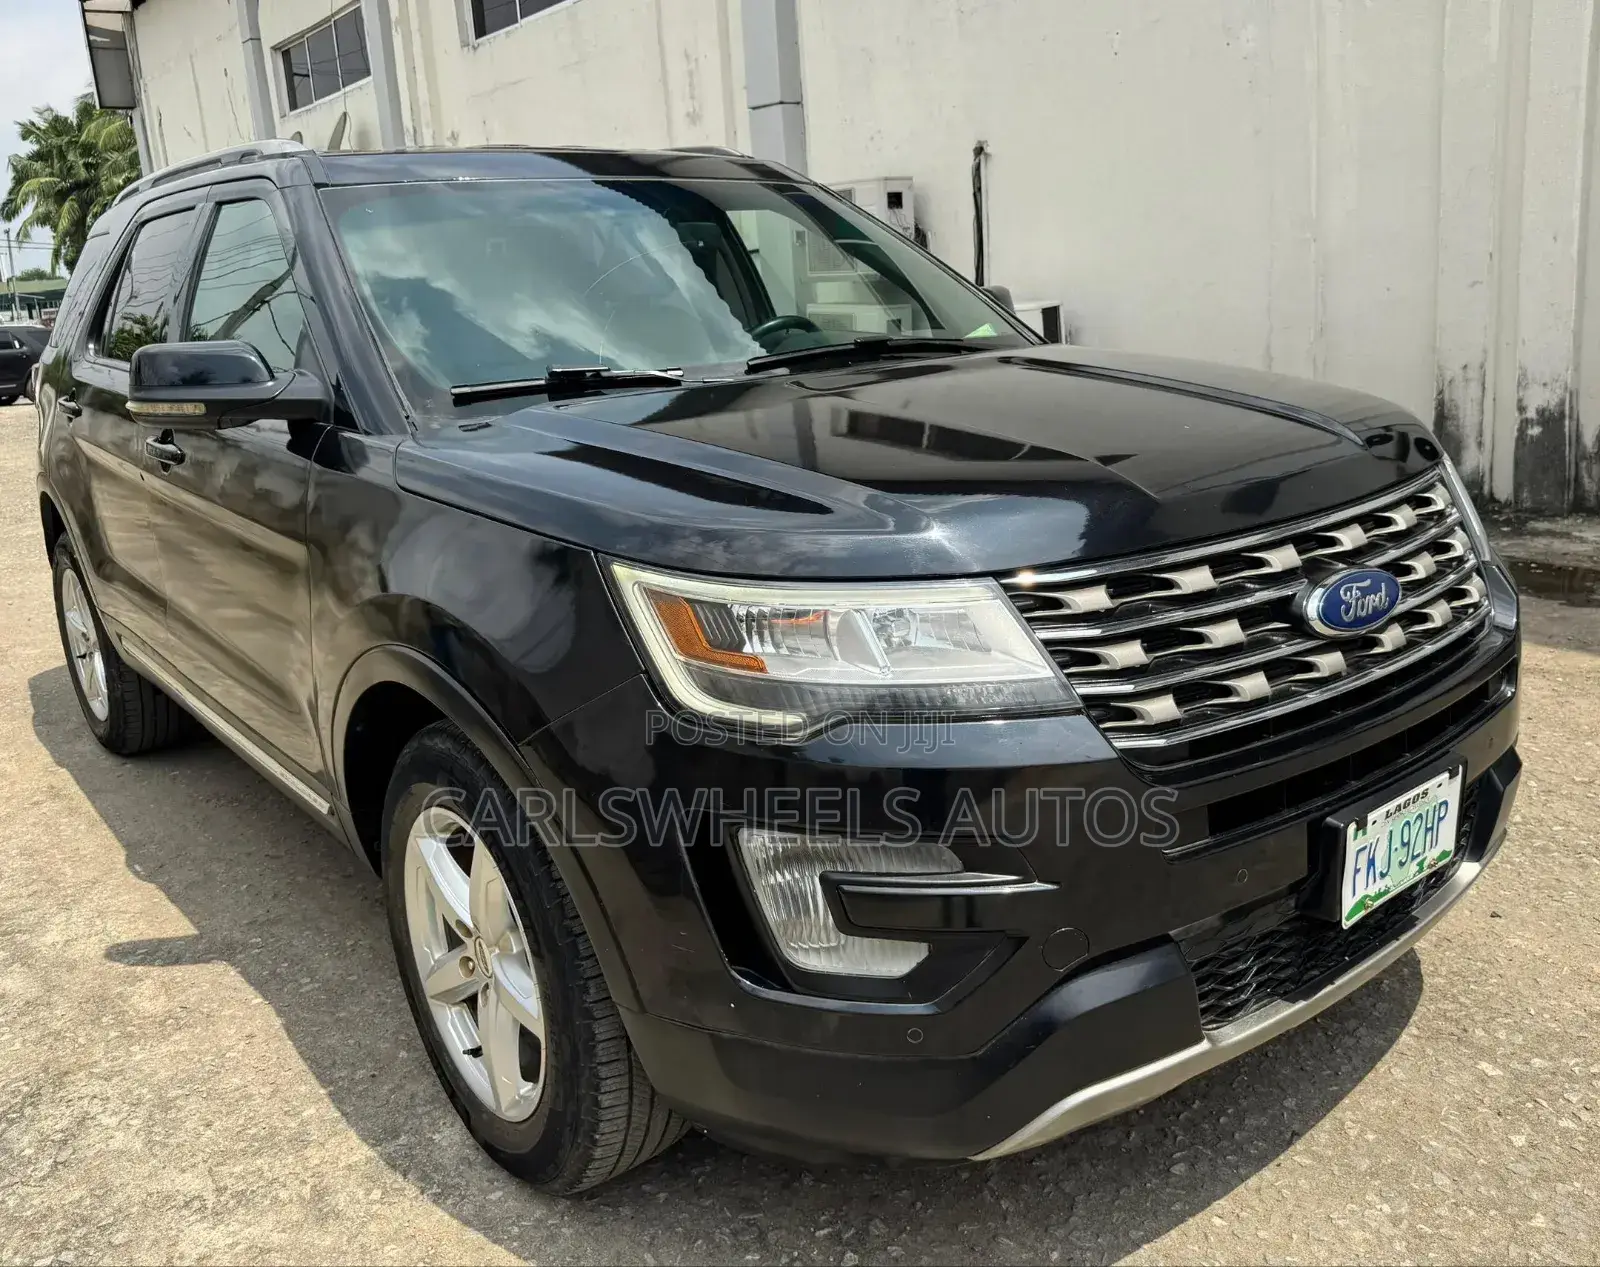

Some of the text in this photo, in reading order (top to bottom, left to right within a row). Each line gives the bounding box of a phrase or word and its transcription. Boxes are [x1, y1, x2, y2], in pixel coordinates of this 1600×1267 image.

[1340, 579, 1389, 622] Ford
[1385, 788, 1429, 819] LAGOS
[1352, 800, 1449, 898] FKJ-92HP
